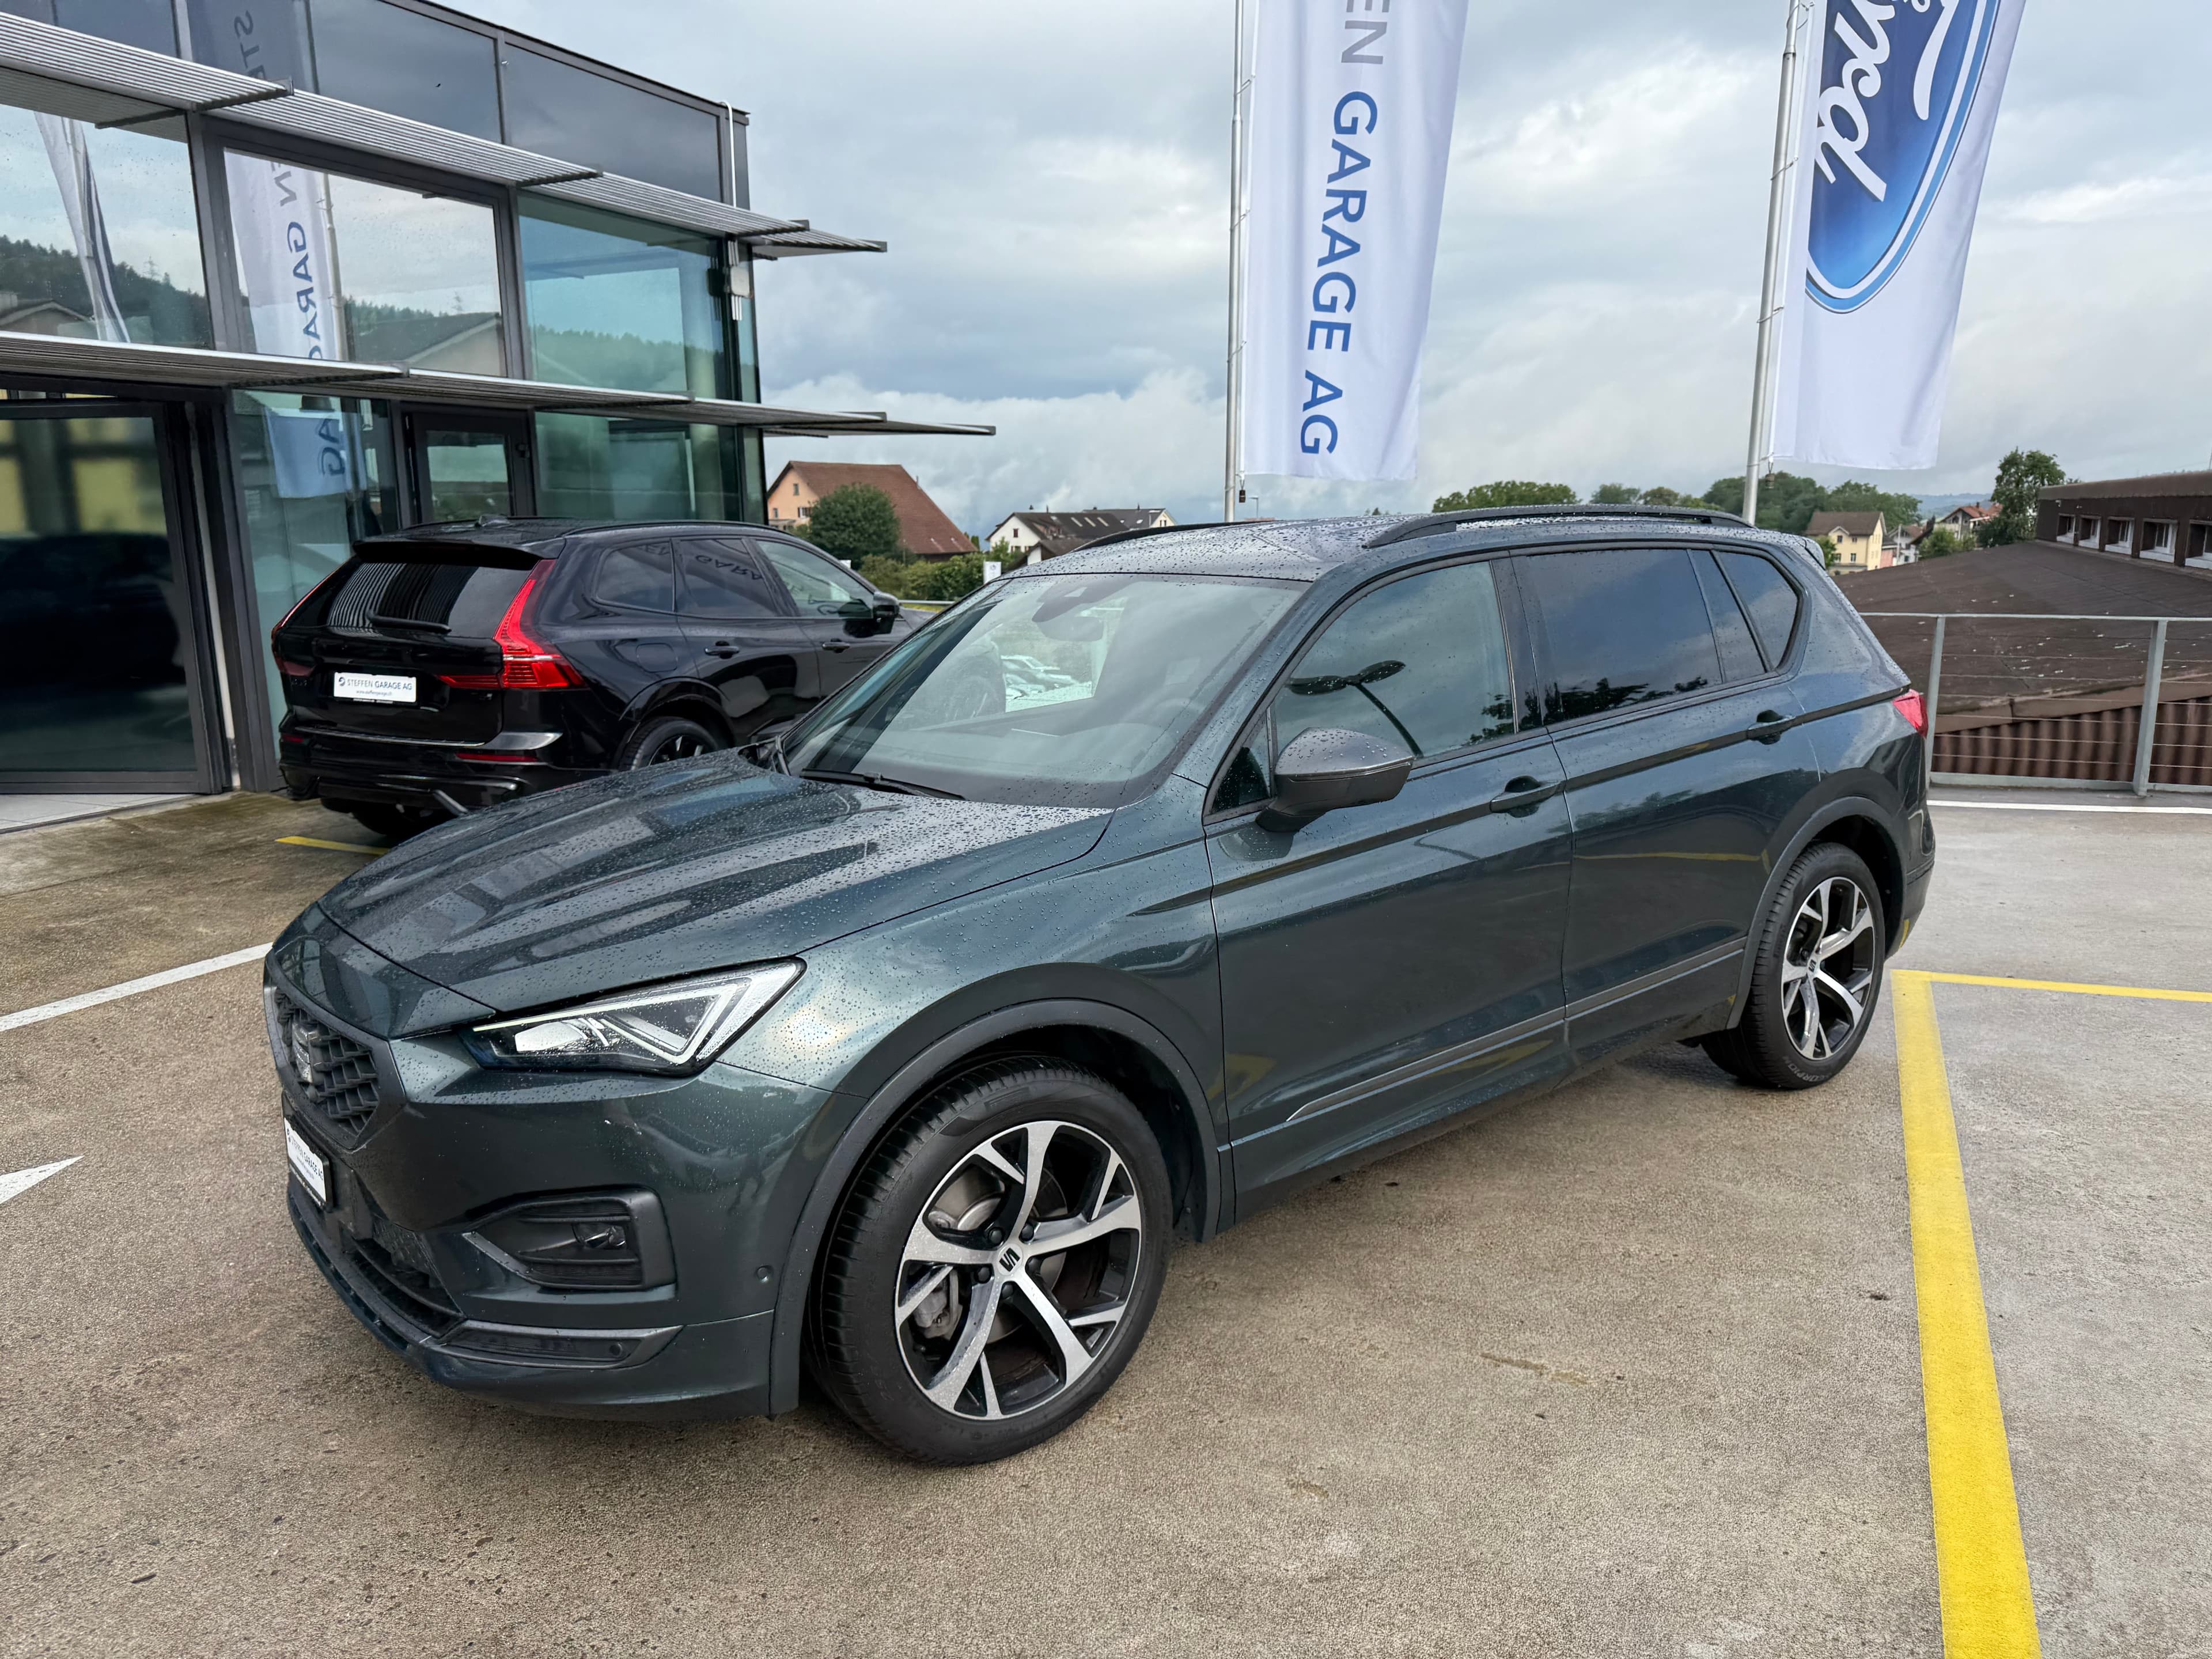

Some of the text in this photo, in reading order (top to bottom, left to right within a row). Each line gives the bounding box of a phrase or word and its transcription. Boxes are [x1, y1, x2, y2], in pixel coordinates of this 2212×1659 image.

[1308, 91, 1378, 352] GARAGE
[1301, 370, 1343, 454] AG
[347, 679, 373, 688] STEFFEN
[374, 680, 401, 690] GARAGE
